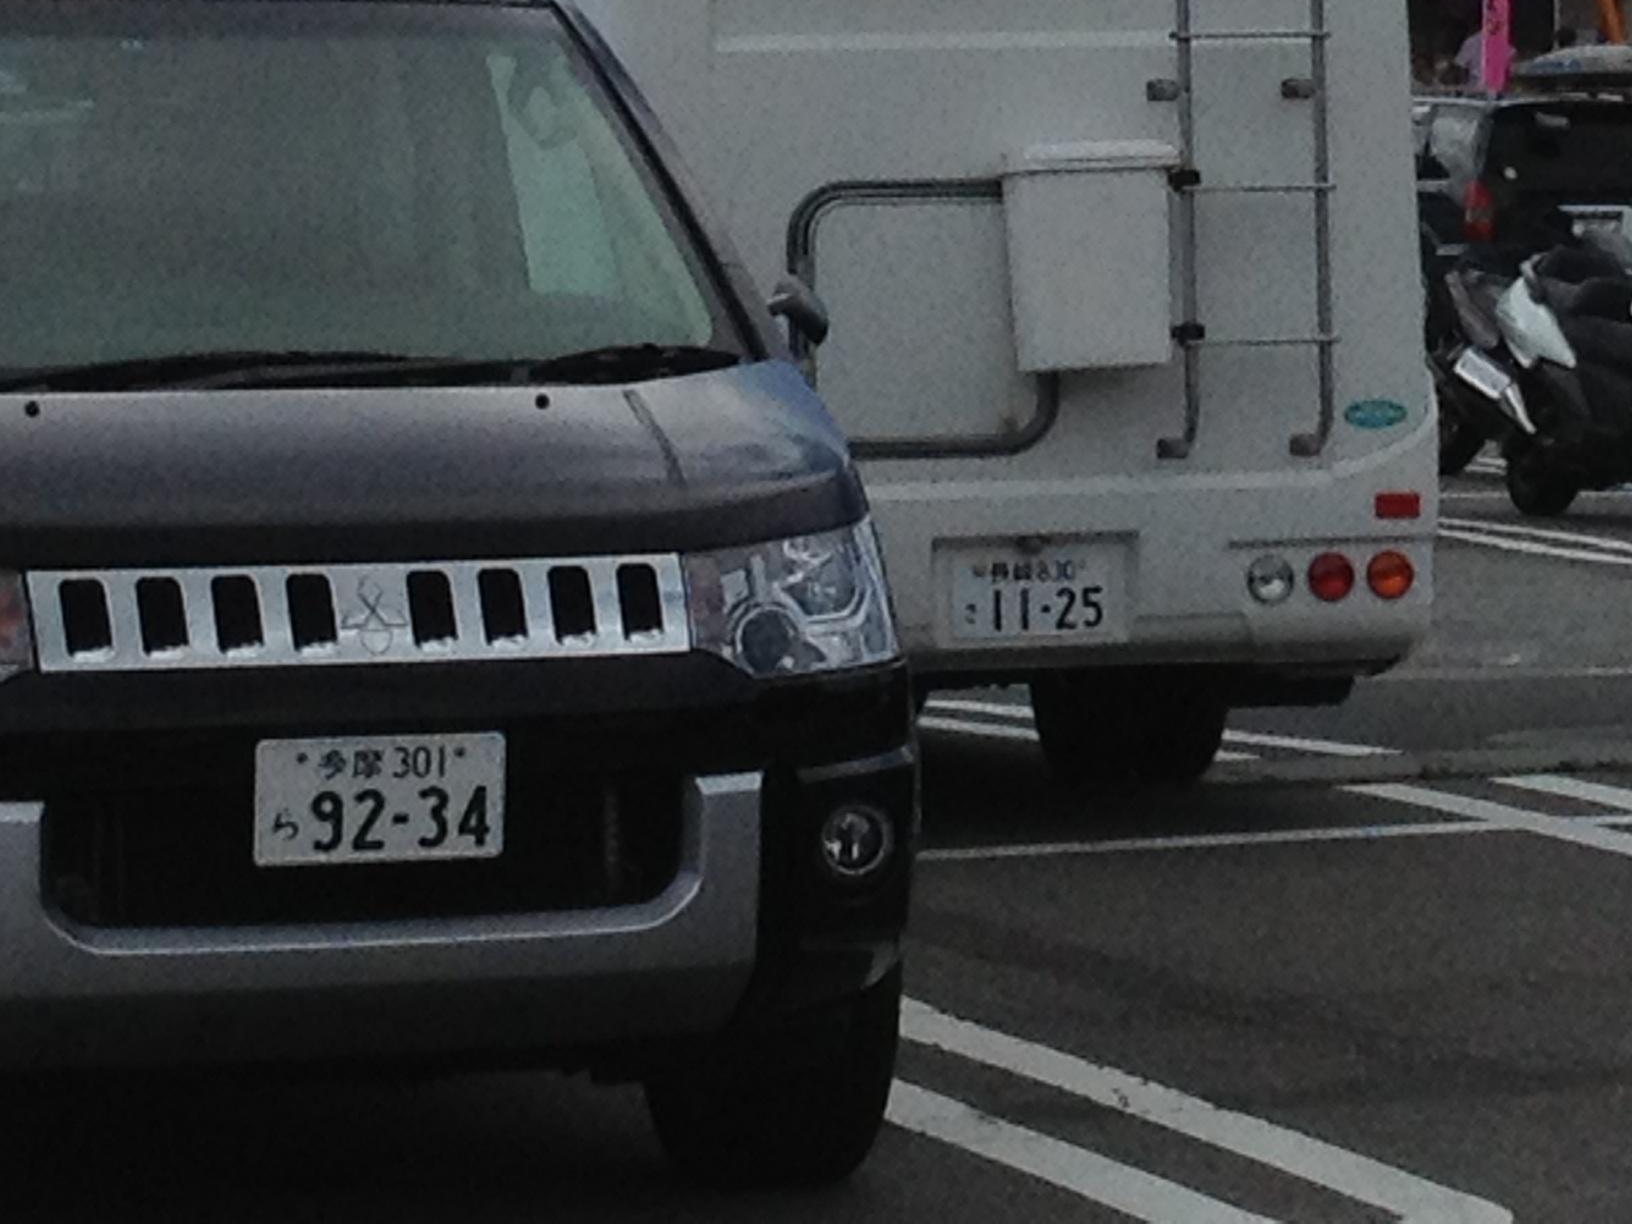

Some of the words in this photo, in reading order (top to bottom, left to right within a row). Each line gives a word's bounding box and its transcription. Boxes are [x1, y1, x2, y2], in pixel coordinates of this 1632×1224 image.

[993, 585, 1104, 633] 11-25
[318, 748, 384, 780] 多摩
[393, 745, 446, 779] 301
[310, 785, 490, 853] 92-34
